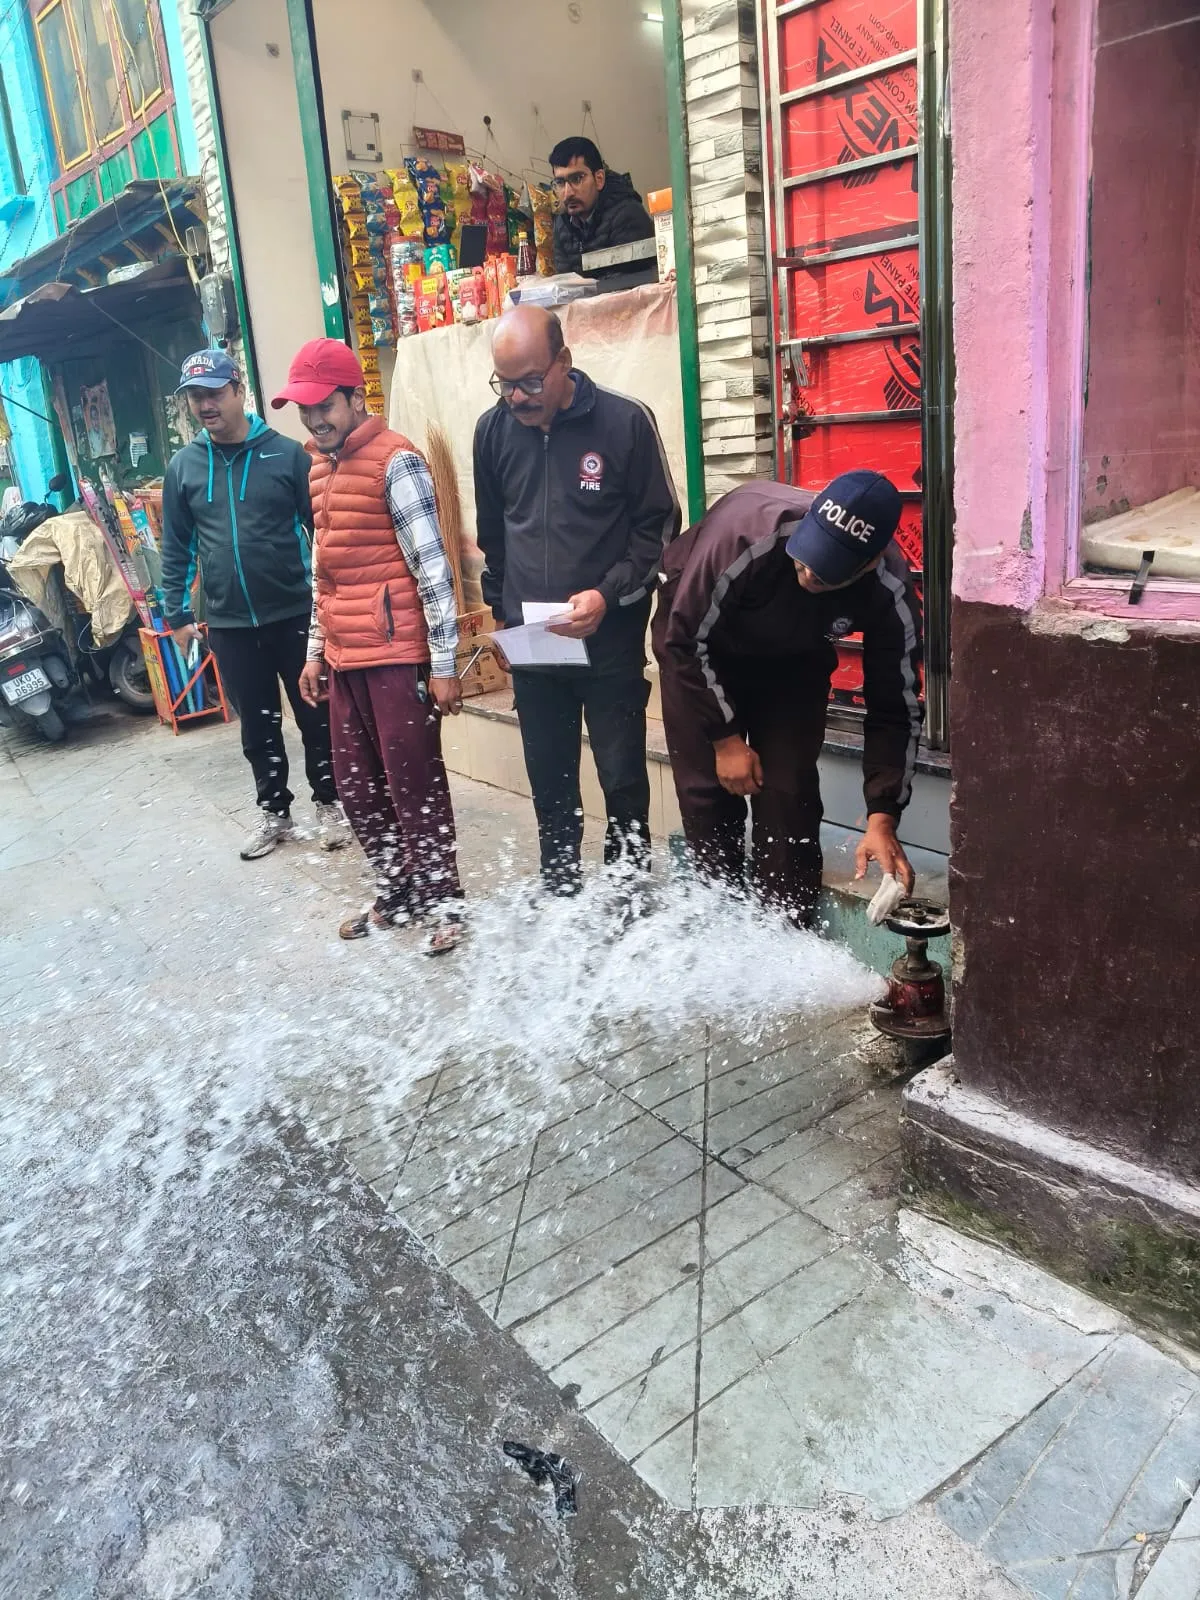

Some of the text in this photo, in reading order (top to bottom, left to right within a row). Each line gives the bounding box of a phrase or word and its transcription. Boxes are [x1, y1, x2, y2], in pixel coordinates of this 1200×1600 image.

[831, 16, 857, 50] PANEL
[580, 480, 601, 491] FIRE
[818, 499, 876, 543] POLICE
[13, 671, 37, 687] UK01
